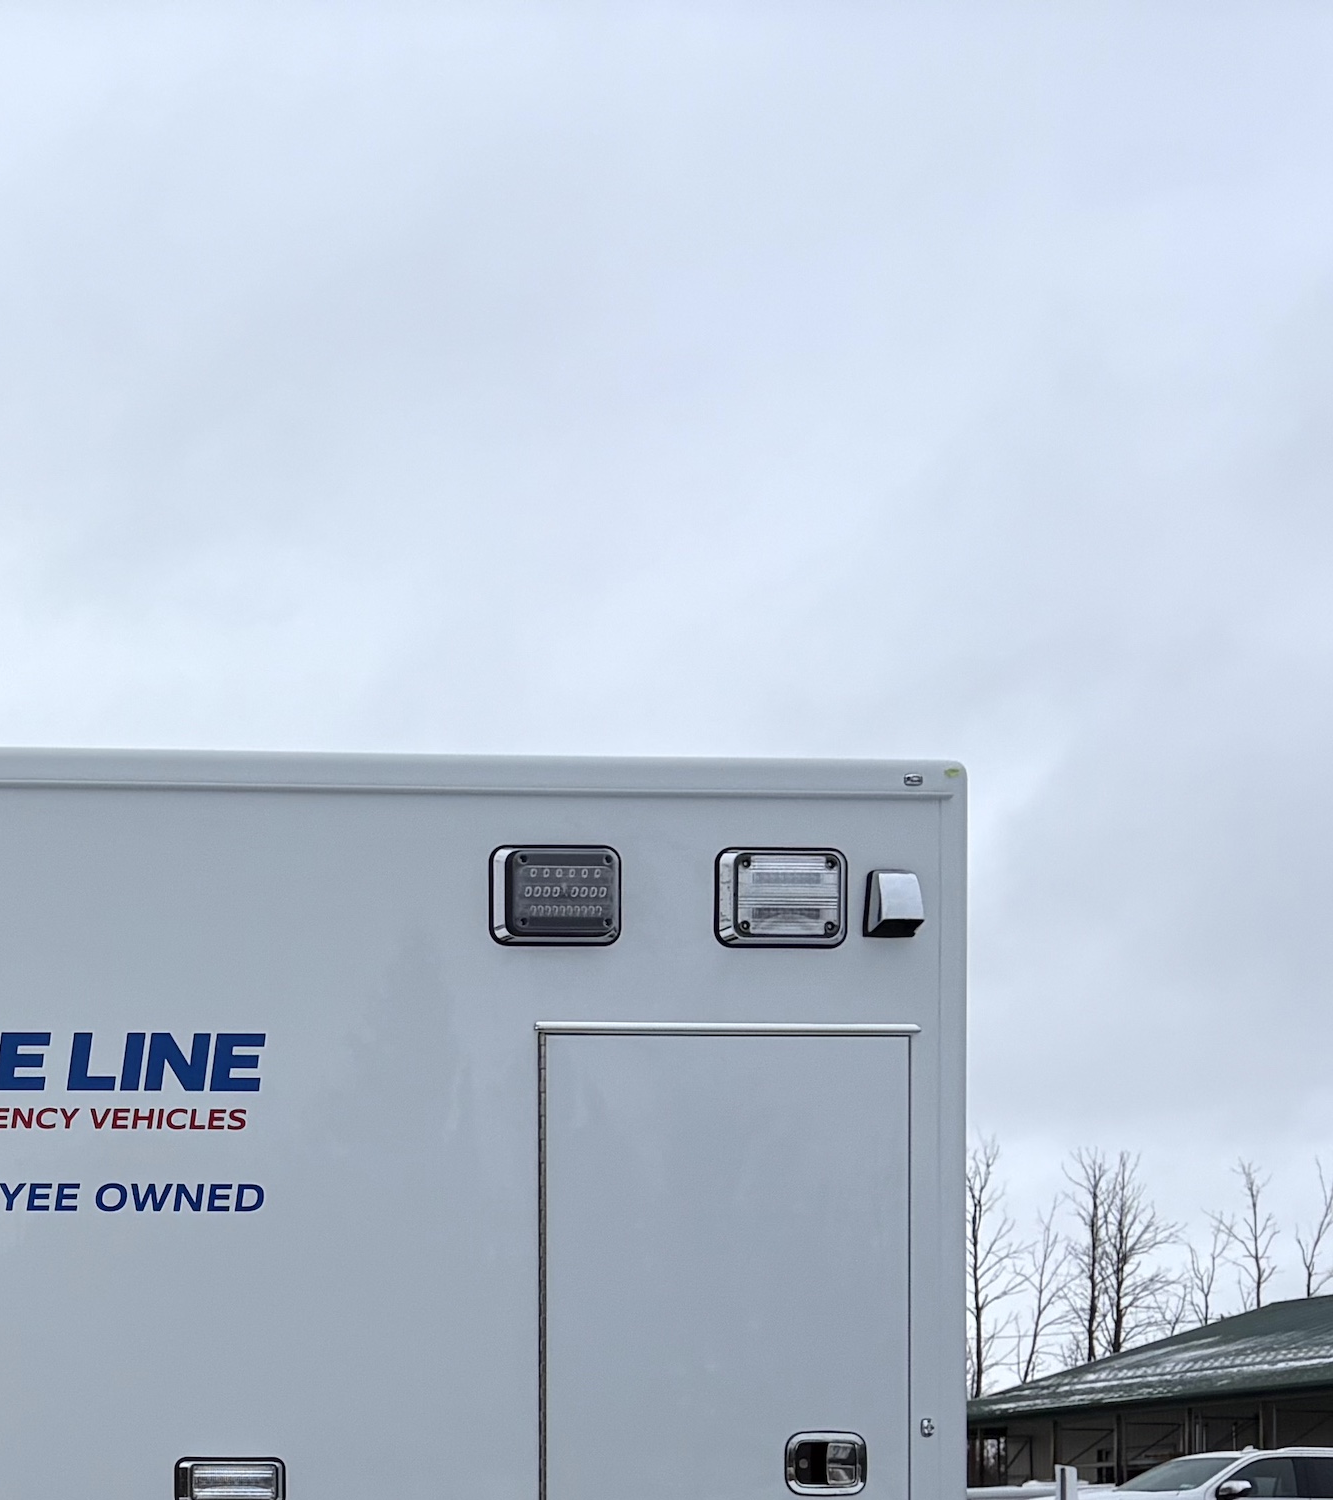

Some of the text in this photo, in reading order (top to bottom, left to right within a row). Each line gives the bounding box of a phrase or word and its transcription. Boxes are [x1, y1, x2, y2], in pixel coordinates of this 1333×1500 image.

[67, 1032, 266, 1092] LINE
[91, 1108, 247, 1130] VEHICLES
[95, 1182, 265, 1212] OWNED
